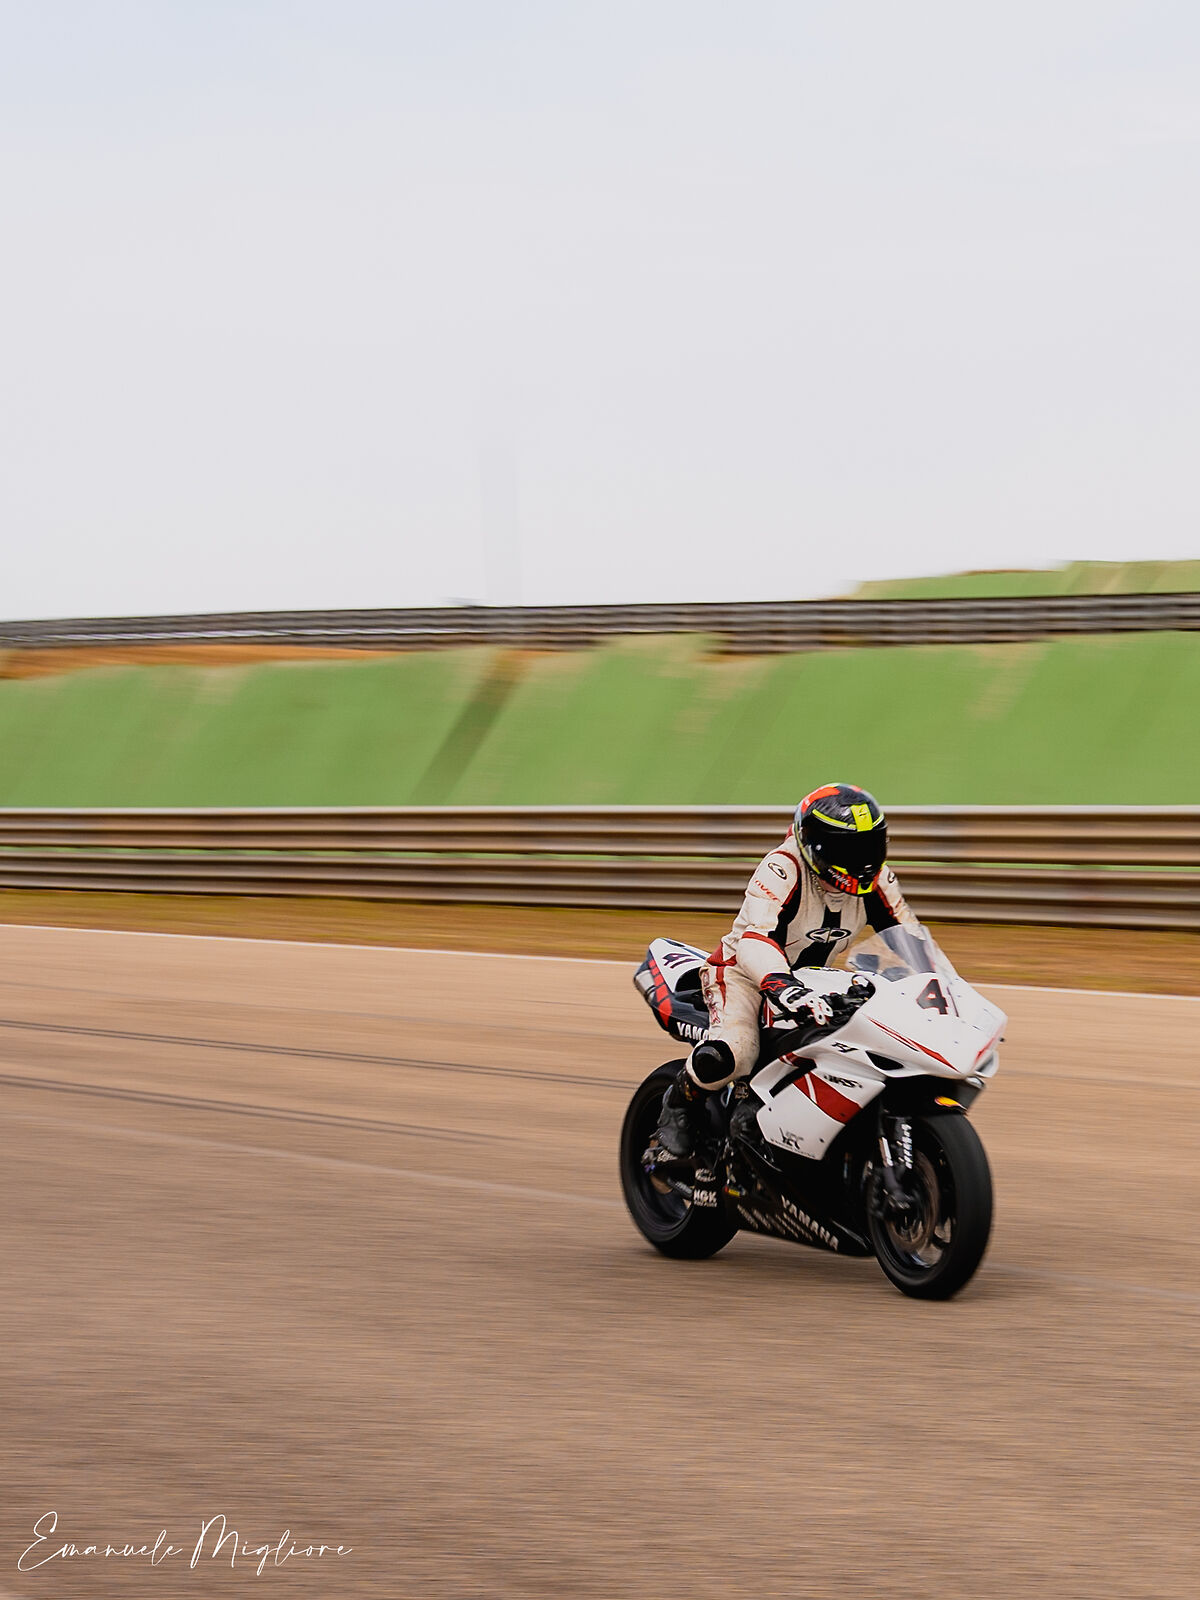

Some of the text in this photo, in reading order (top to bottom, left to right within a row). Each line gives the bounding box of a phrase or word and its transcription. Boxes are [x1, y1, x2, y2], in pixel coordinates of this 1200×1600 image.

[662, 952, 701, 969] 41
[676, 1021, 710, 1041] YAMA
[781, 1194, 839, 1251] YAMAHA
